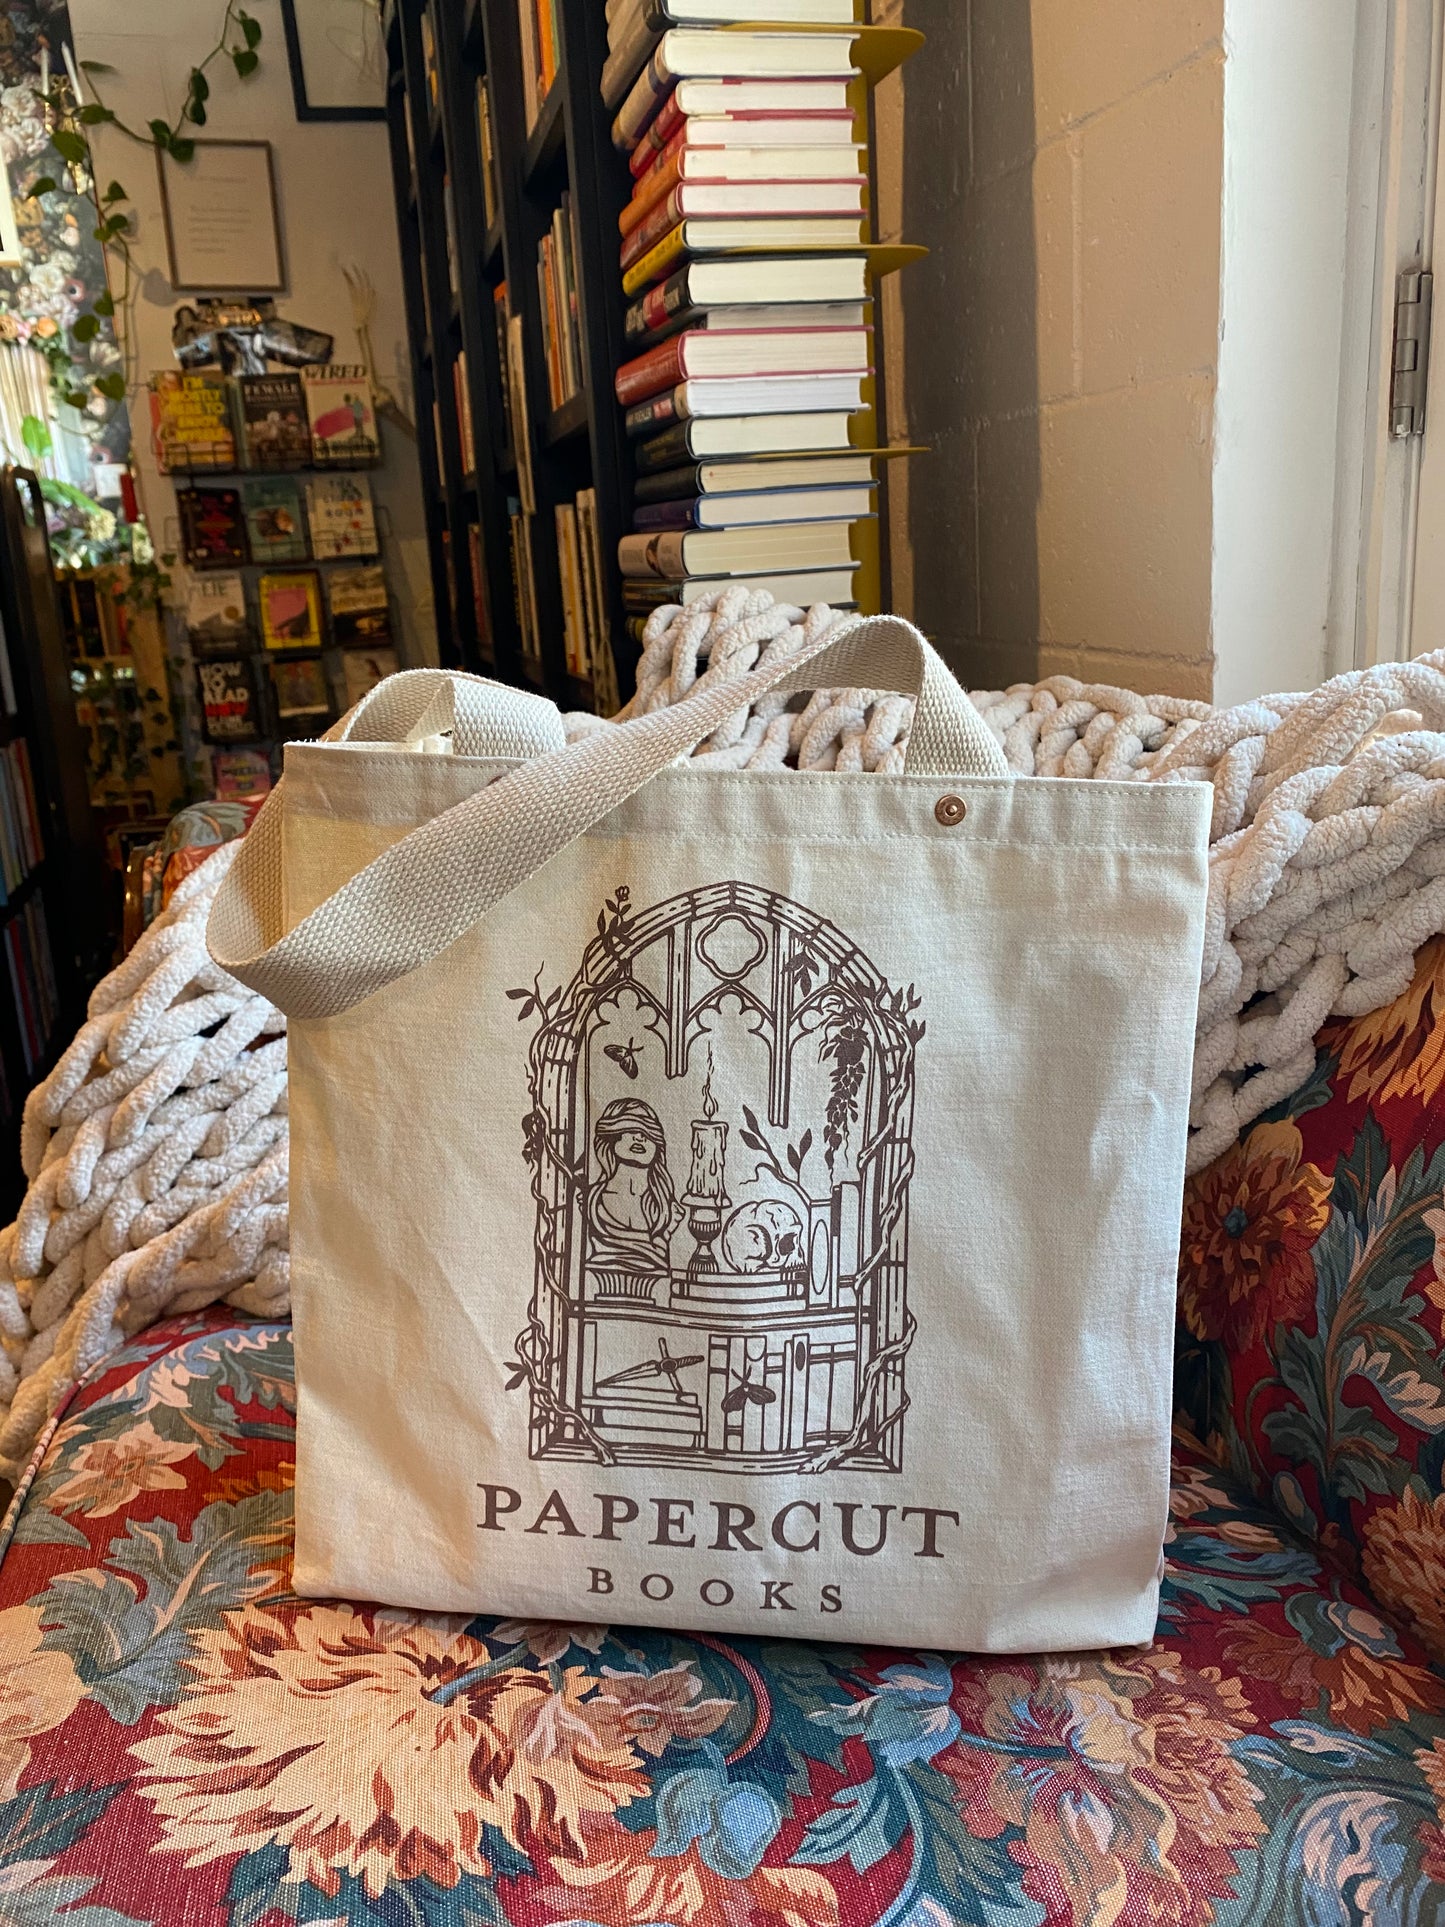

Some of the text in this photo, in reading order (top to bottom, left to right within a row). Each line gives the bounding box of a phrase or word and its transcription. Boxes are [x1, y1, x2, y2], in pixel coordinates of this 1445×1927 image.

[304, 365, 367, 379] WIRED
[199, 661, 242, 679] HOW
[201, 675, 226, 692] TO
[203, 687, 249, 705] READ
[476, 1483, 959, 1558] PAPERCUT
[586, 1567, 842, 1613] BOOKS
